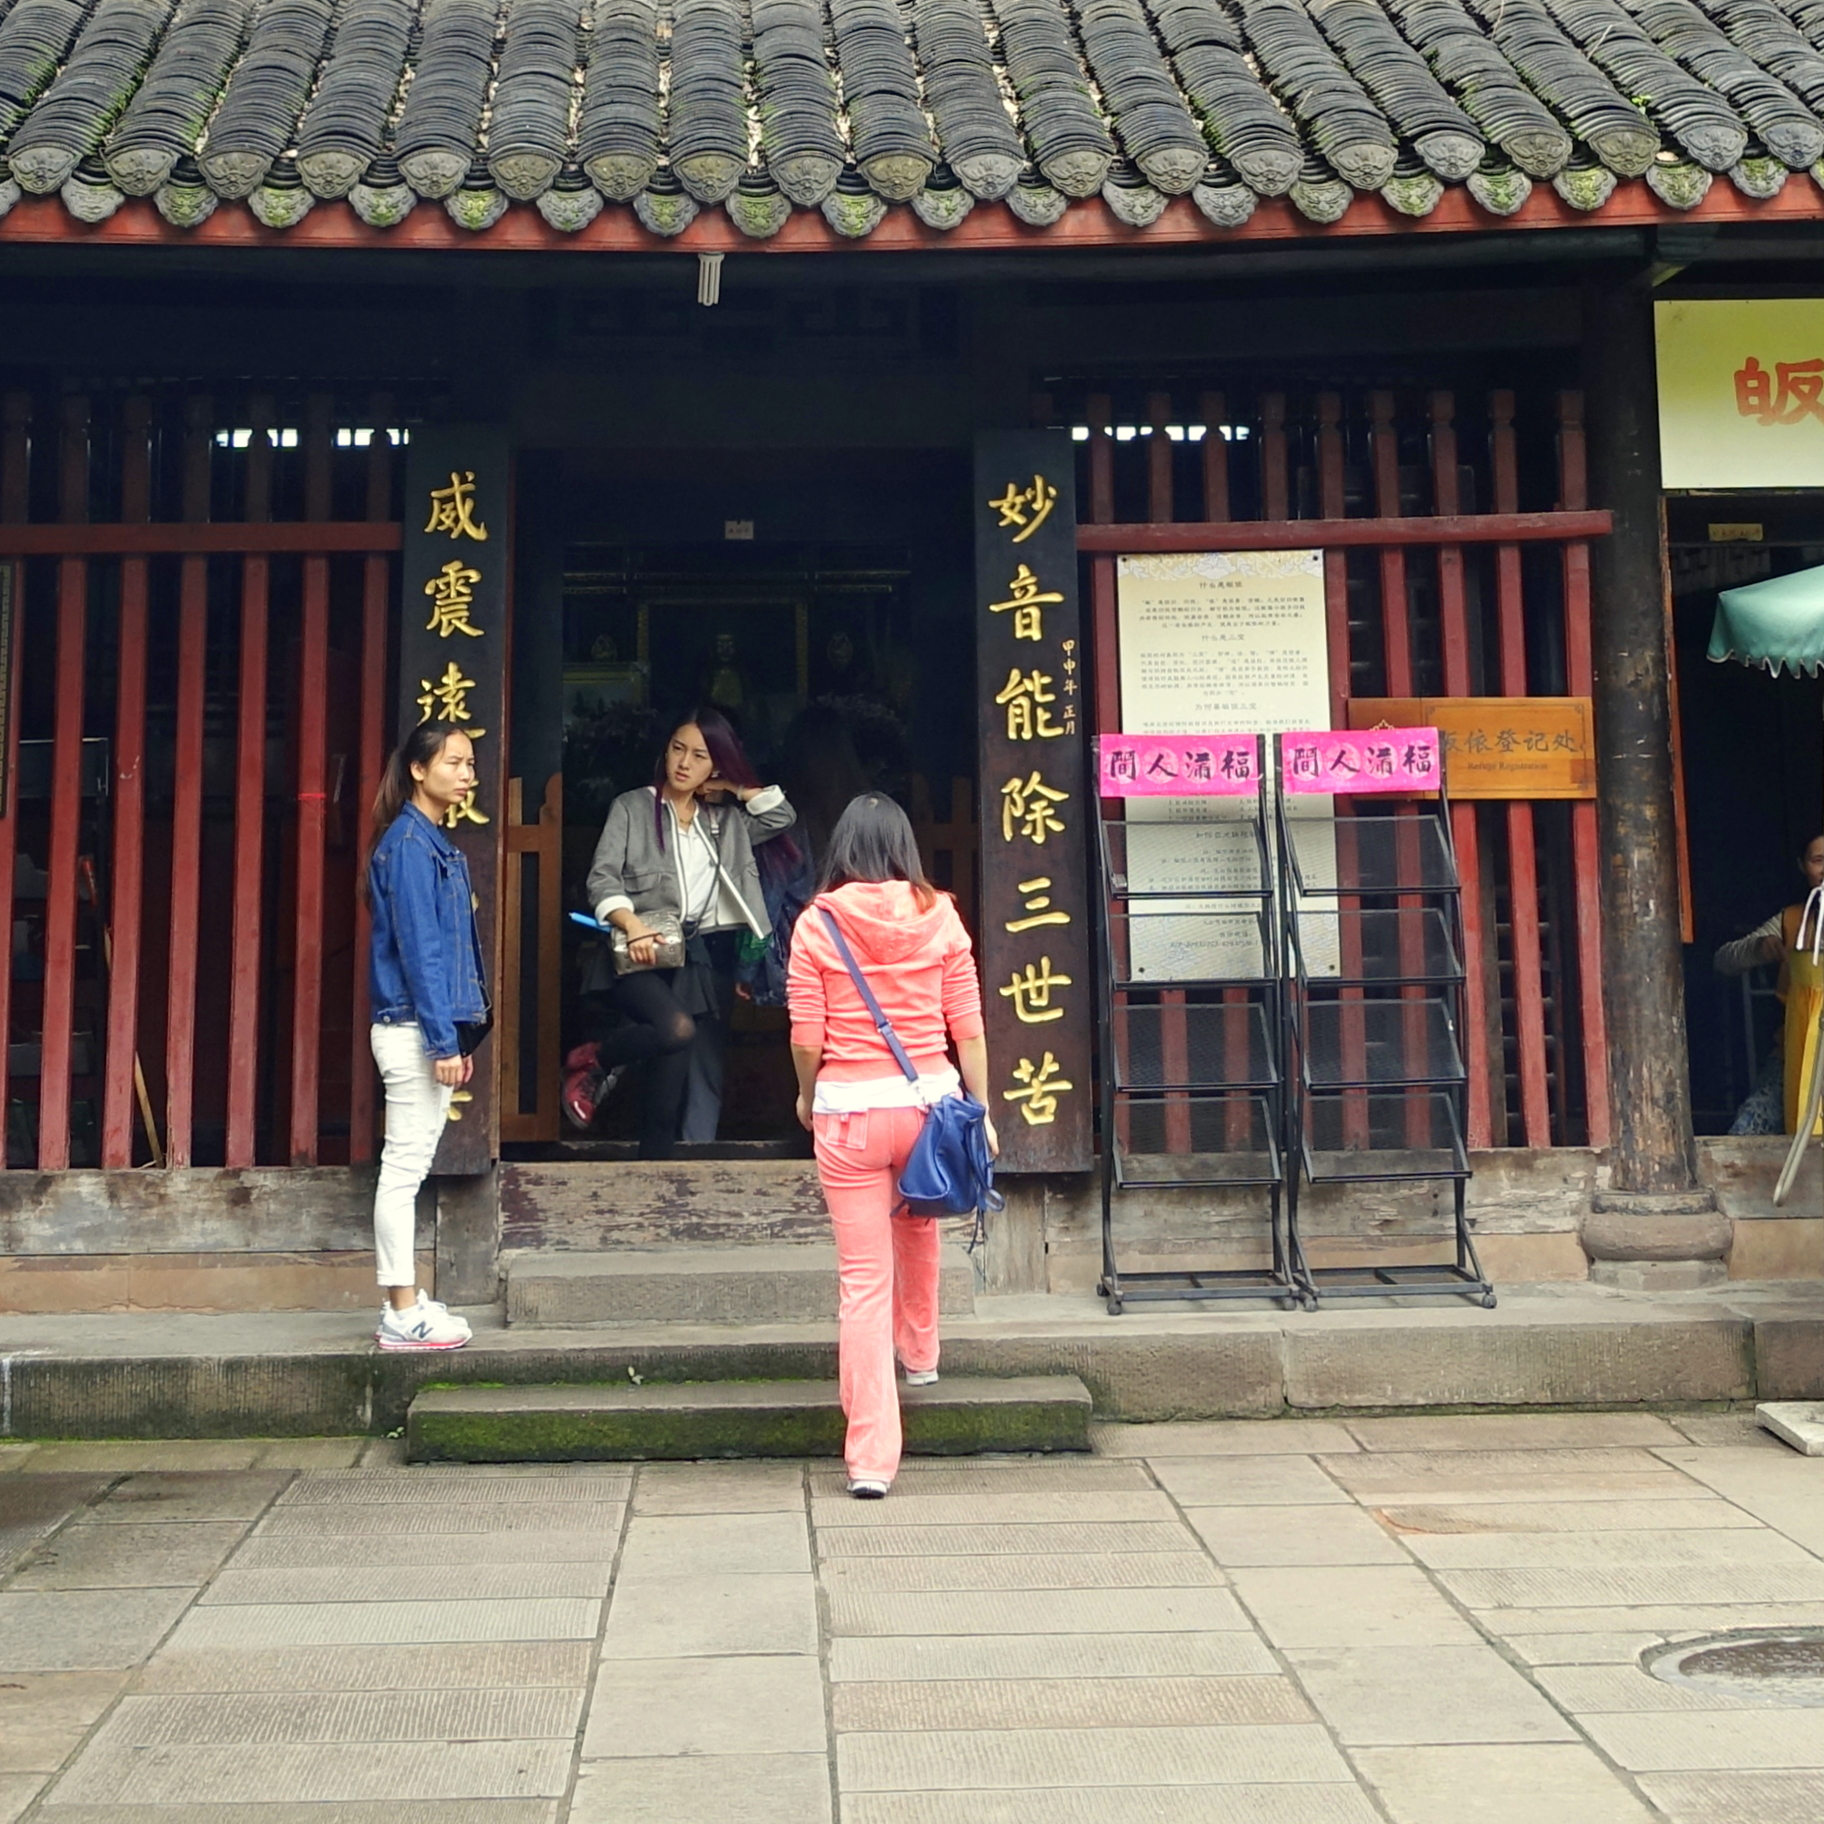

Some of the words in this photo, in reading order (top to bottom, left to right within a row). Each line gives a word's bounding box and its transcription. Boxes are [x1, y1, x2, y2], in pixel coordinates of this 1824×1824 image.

[988, 474, 1072, 1127] 妙音能除三世苦
